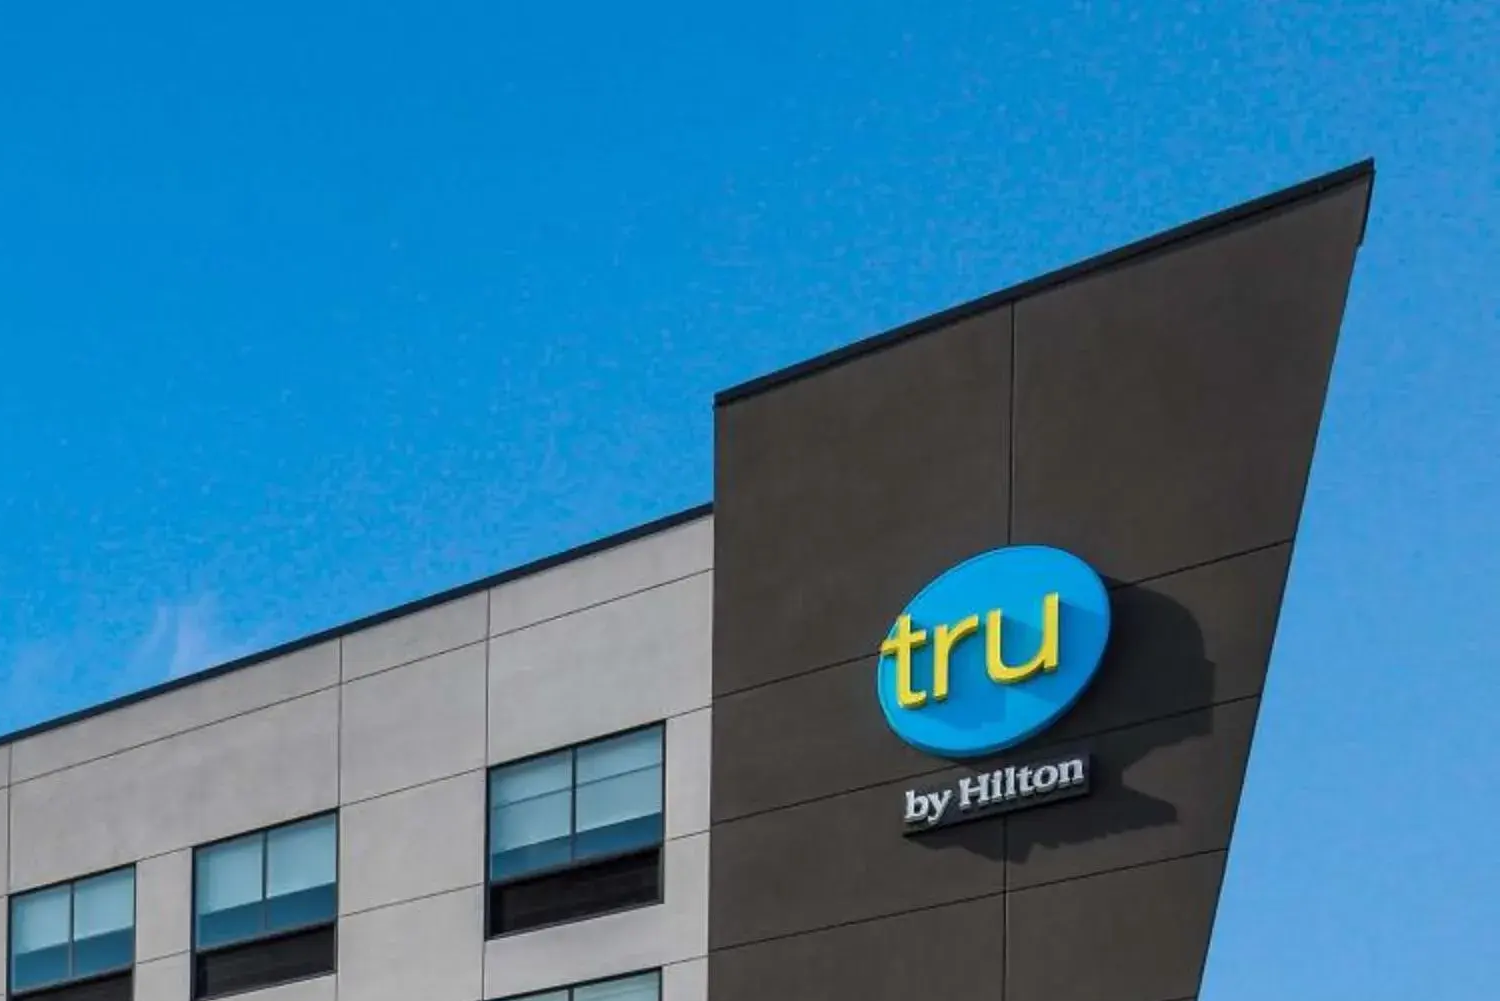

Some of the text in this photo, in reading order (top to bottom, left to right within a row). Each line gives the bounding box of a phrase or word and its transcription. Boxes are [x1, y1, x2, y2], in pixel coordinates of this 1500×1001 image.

[881, 591, 1059, 709] tru
[904, 757, 1084, 825] by Hilton
